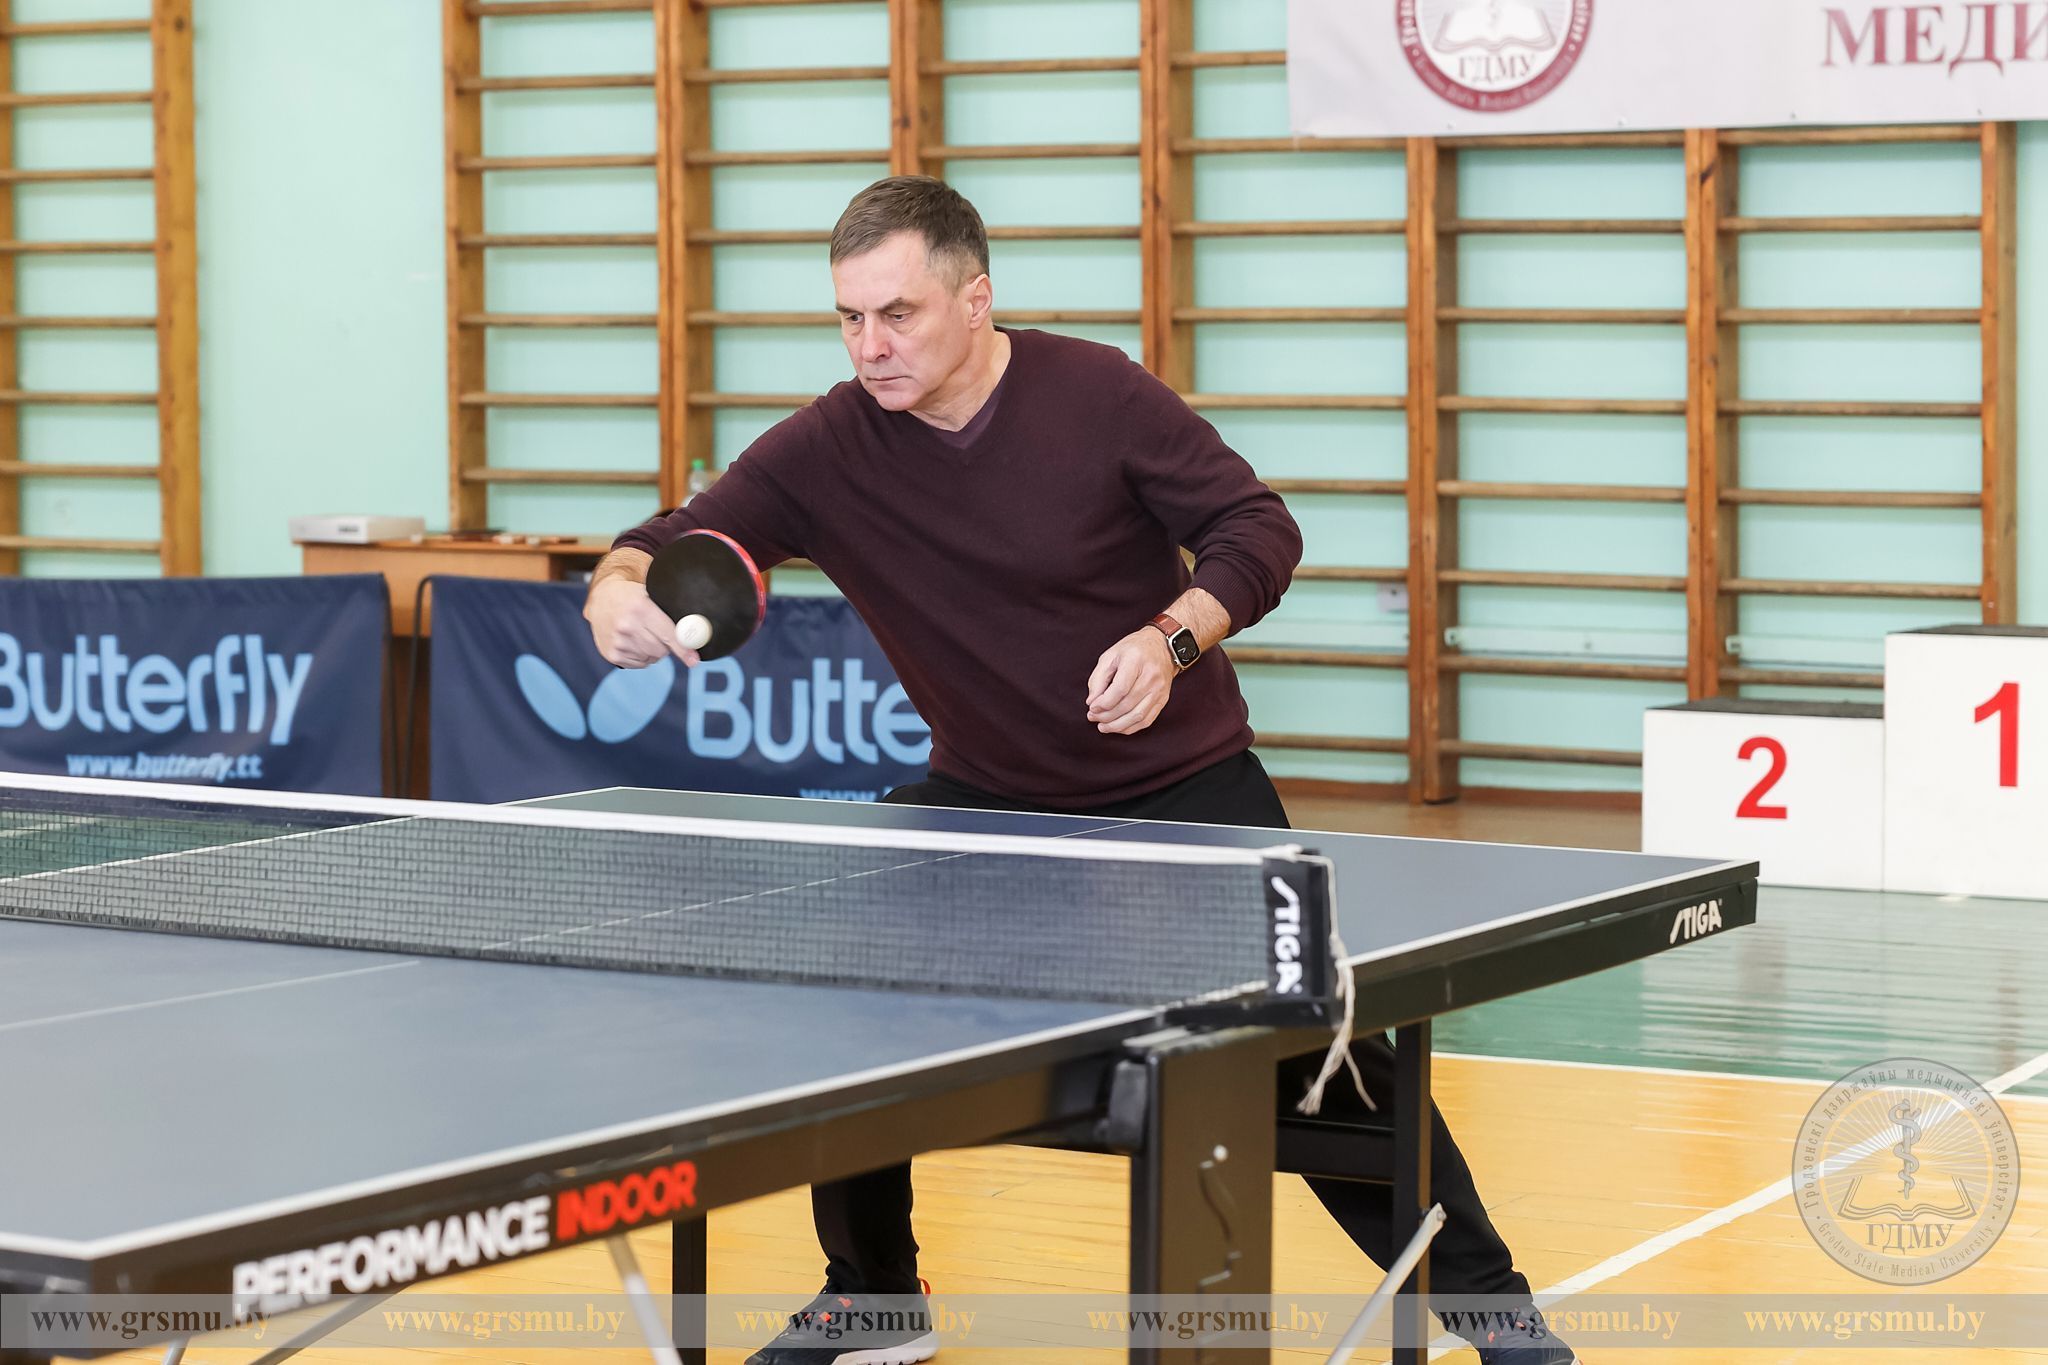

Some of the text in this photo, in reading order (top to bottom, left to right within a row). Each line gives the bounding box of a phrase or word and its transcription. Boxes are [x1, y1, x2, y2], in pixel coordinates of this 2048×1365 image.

[1822, 3, 2048, 78] МЕДИ
[1736, 736, 1788, 820] 2
[1974, 682, 2020, 788] 1
[1271, 876, 1303, 994] STIGA
[1669, 899, 1723, 944] STIGA
[232, 1161, 699, 1324] PERFORMANCE INDOOR
